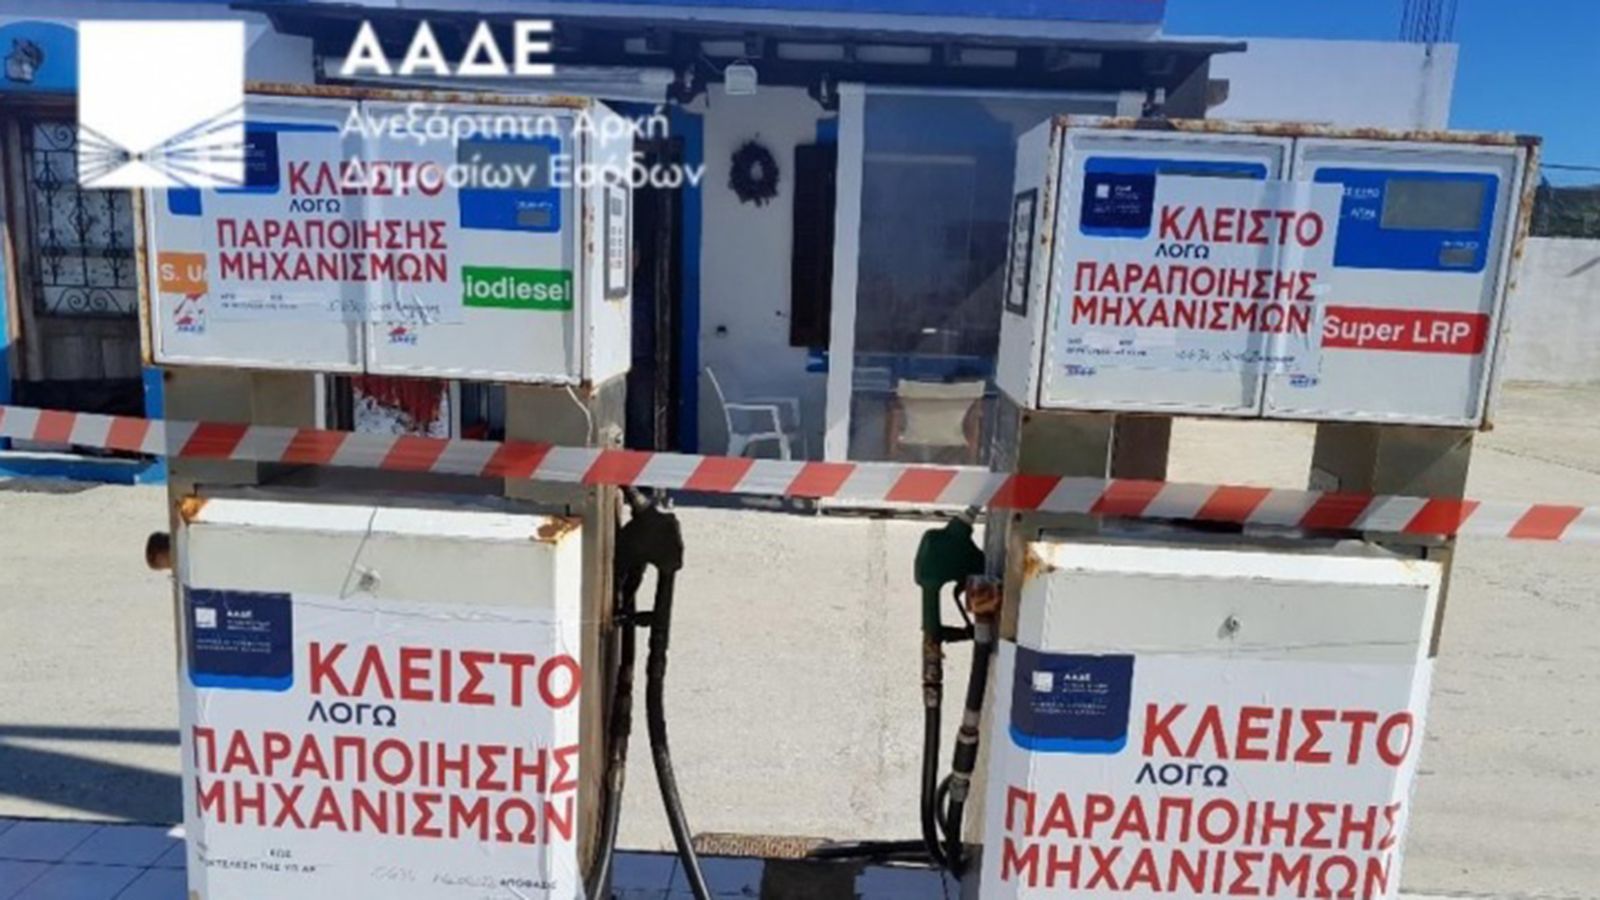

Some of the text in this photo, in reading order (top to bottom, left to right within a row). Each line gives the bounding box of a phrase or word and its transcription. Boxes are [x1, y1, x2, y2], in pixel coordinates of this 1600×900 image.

[289, 198, 341, 213] ΛΟΓΩ
[216, 218, 448, 250] ΠΑΡΑΠΟΙΗΣΗΣ
[1159, 205, 1325, 247] ΚΛΕΙΣΤΟ
[219, 251, 448, 283] ΜΗΧΑΝΙΣΜΩΝ
[1154, 243, 1211, 260] ΛΟΓΩ
[465, 275, 571, 301] iodiesel
[1074, 262, 1318, 301] ΠΑΡΑΠΟΙΗΣΗΣ
[1071, 295, 1313, 334] ΜΗΧΑΝΙΣΜΩΝ
[1323, 315, 1471, 346] Super LRP
[308, 641, 582, 709] ΚΛΕΙΣΤΟ
[307, 700, 397, 727] ΛΟΓΩ
[1141, 702, 1414, 767] ΚΛΕΙΣΤΟ
[192, 724, 580, 794] ΠΑΡΑΠΟΙΗΣΗΣ
[1135, 762, 1229, 787] ΛΟΓΩ
[195, 776, 575, 845] ΜΗΧΑΝΙΣΜΩΝ
[1005, 785, 1401, 851] ΠΑΡΑΠΟΙΗΣΗΣ
[1000, 836, 1393, 900] ΜΗΧΑΝΙΣΜΩΝ
